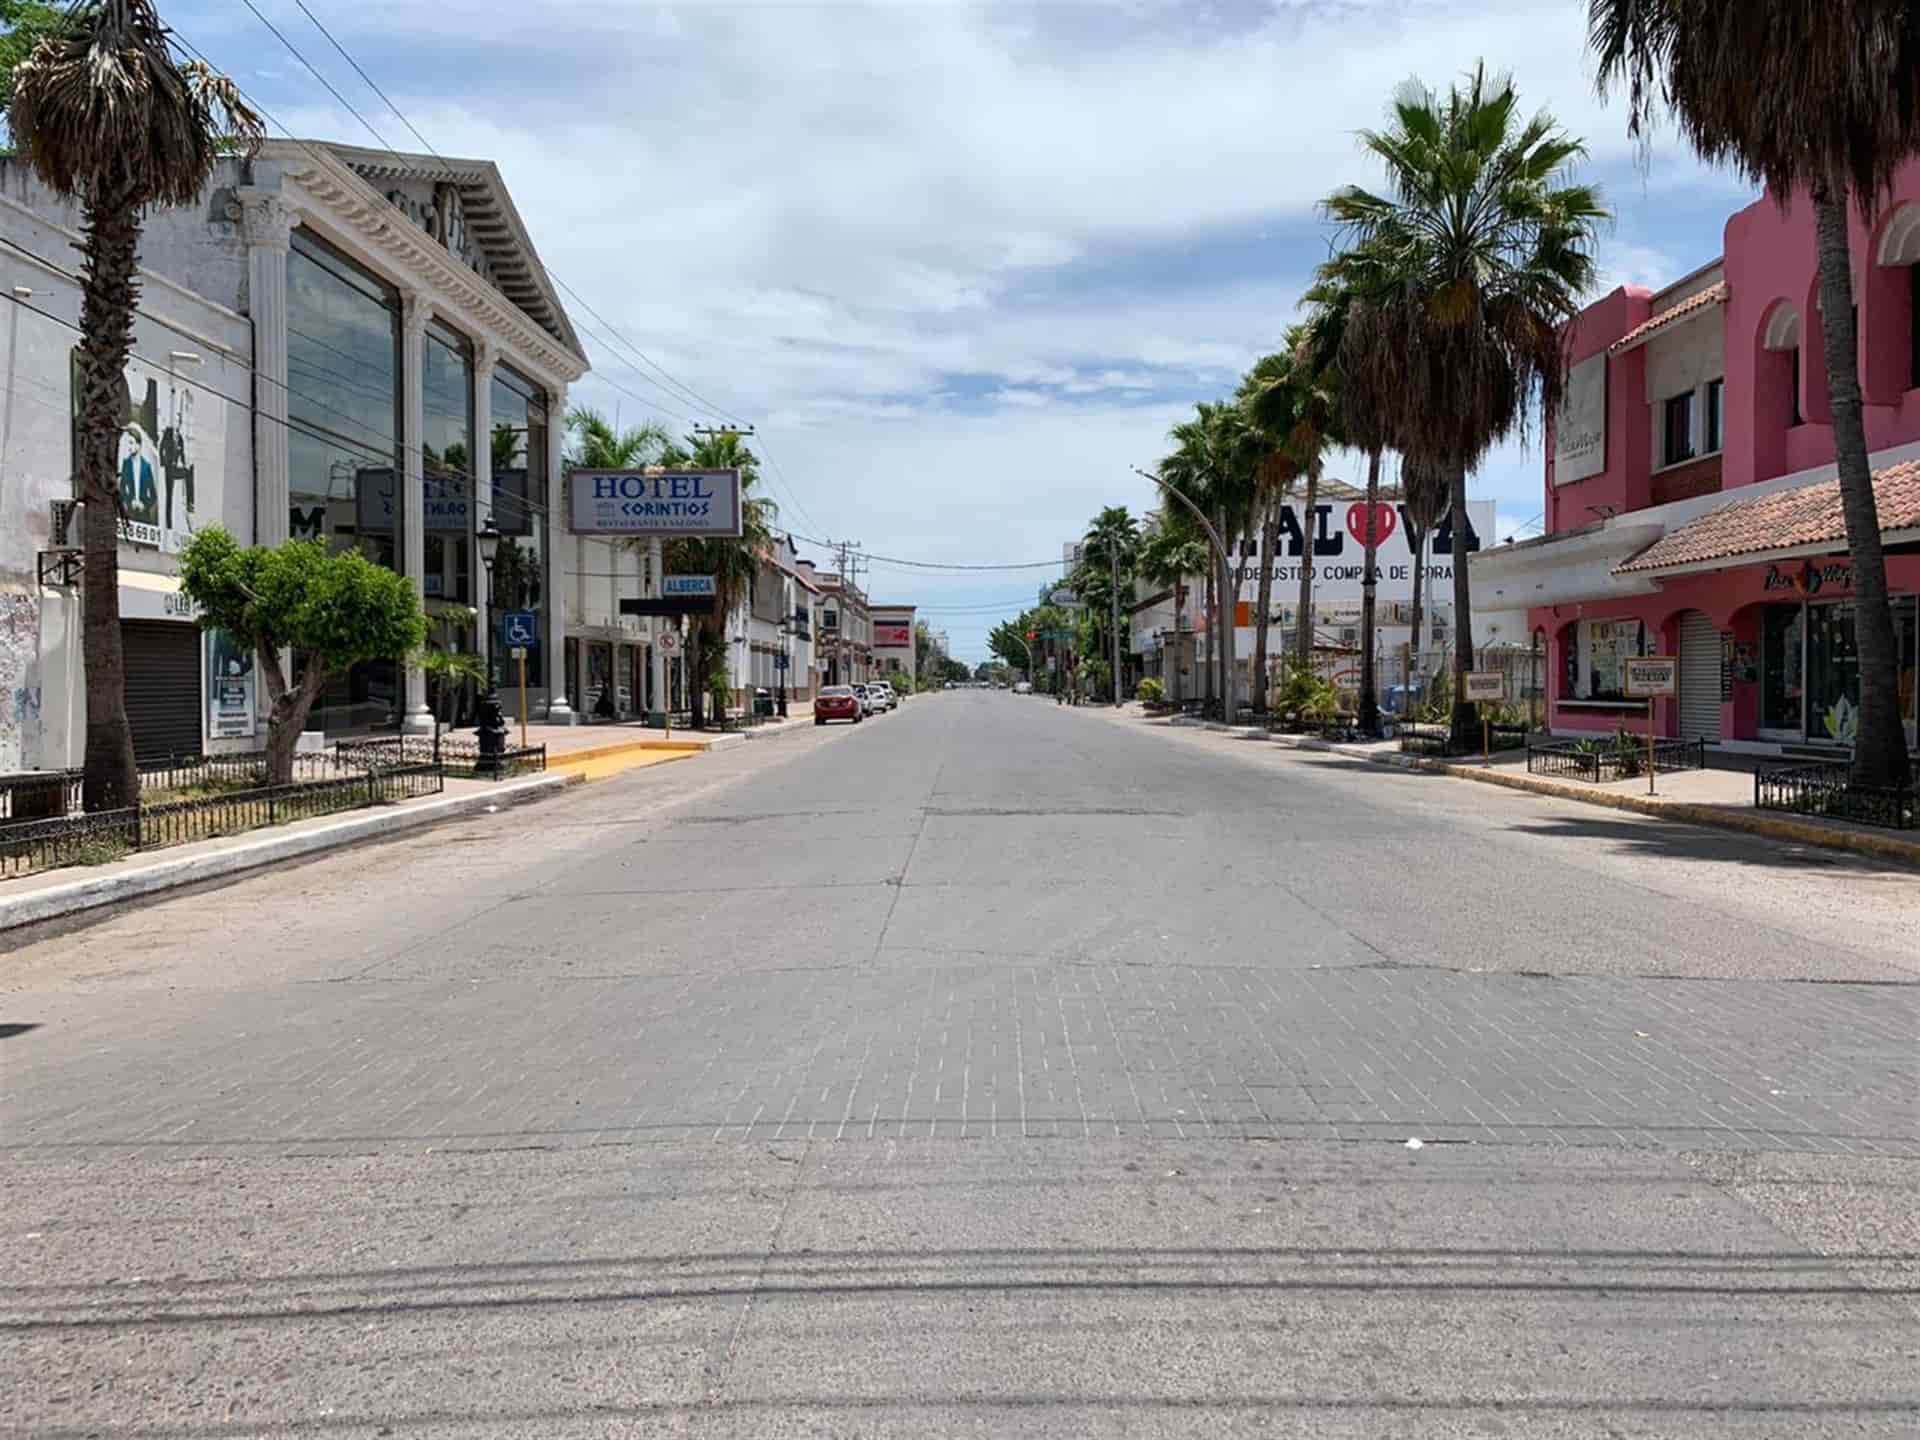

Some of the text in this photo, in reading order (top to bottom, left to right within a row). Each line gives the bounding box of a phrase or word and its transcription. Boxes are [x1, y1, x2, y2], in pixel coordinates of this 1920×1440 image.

[592, 477, 713, 498] HOTEL
[621, 502, 710, 516] CORINTIOS
[1323, 566, 1383, 580] COMPA
[1389, 566, 1409, 580] DE
[665, 579, 714, 593] ALBERCA
